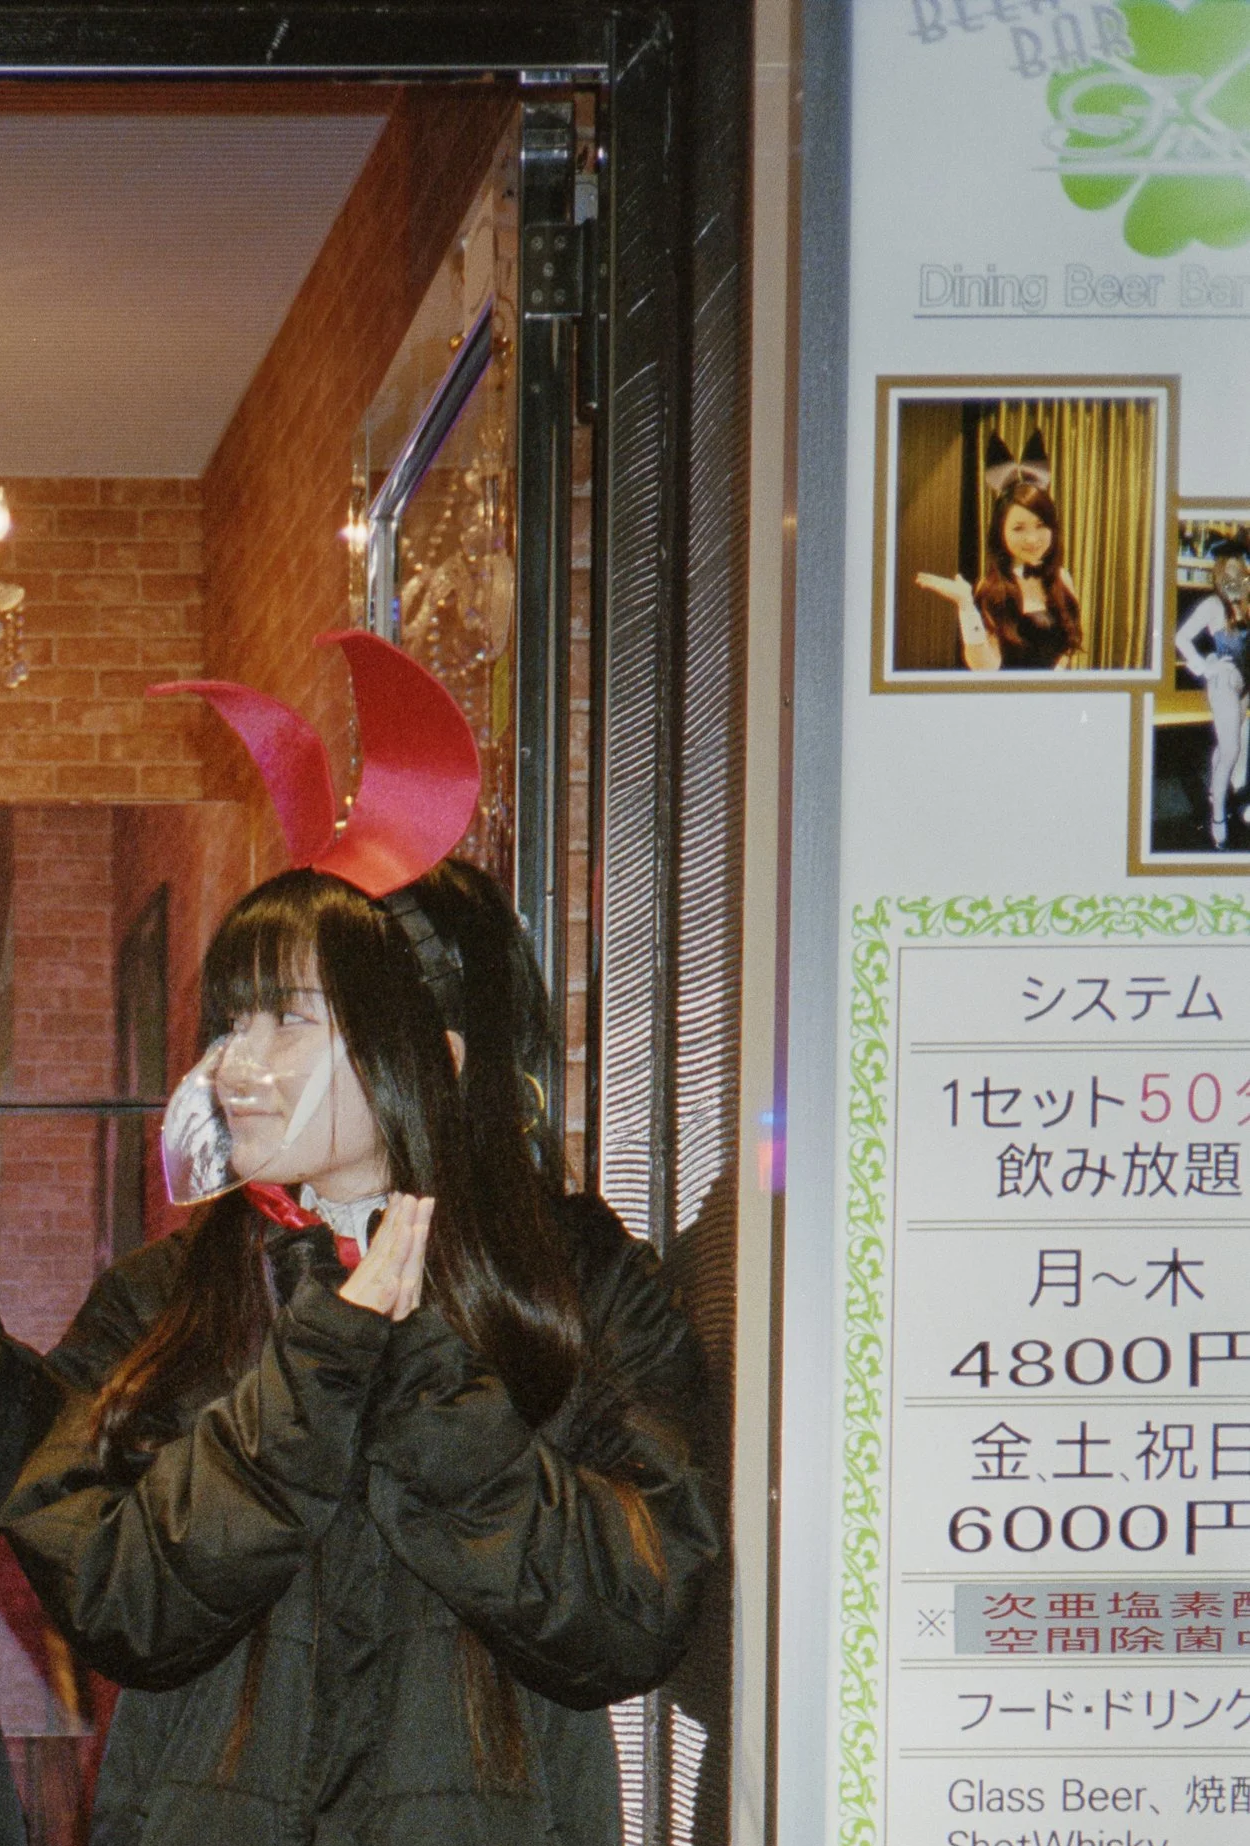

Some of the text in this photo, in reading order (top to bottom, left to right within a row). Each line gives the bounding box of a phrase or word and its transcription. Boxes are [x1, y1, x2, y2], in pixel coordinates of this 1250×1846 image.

[918, 263, 1048, 312] Dining
[1064, 263, 1166, 308] Beer
[1022, 974, 1223, 1022] システム
[996, 1141, 1243, 1199] 飲み放題
[983, 1625, 1250, 1654] 空間除菌
[948, 1778, 1045, 1813] Glass
